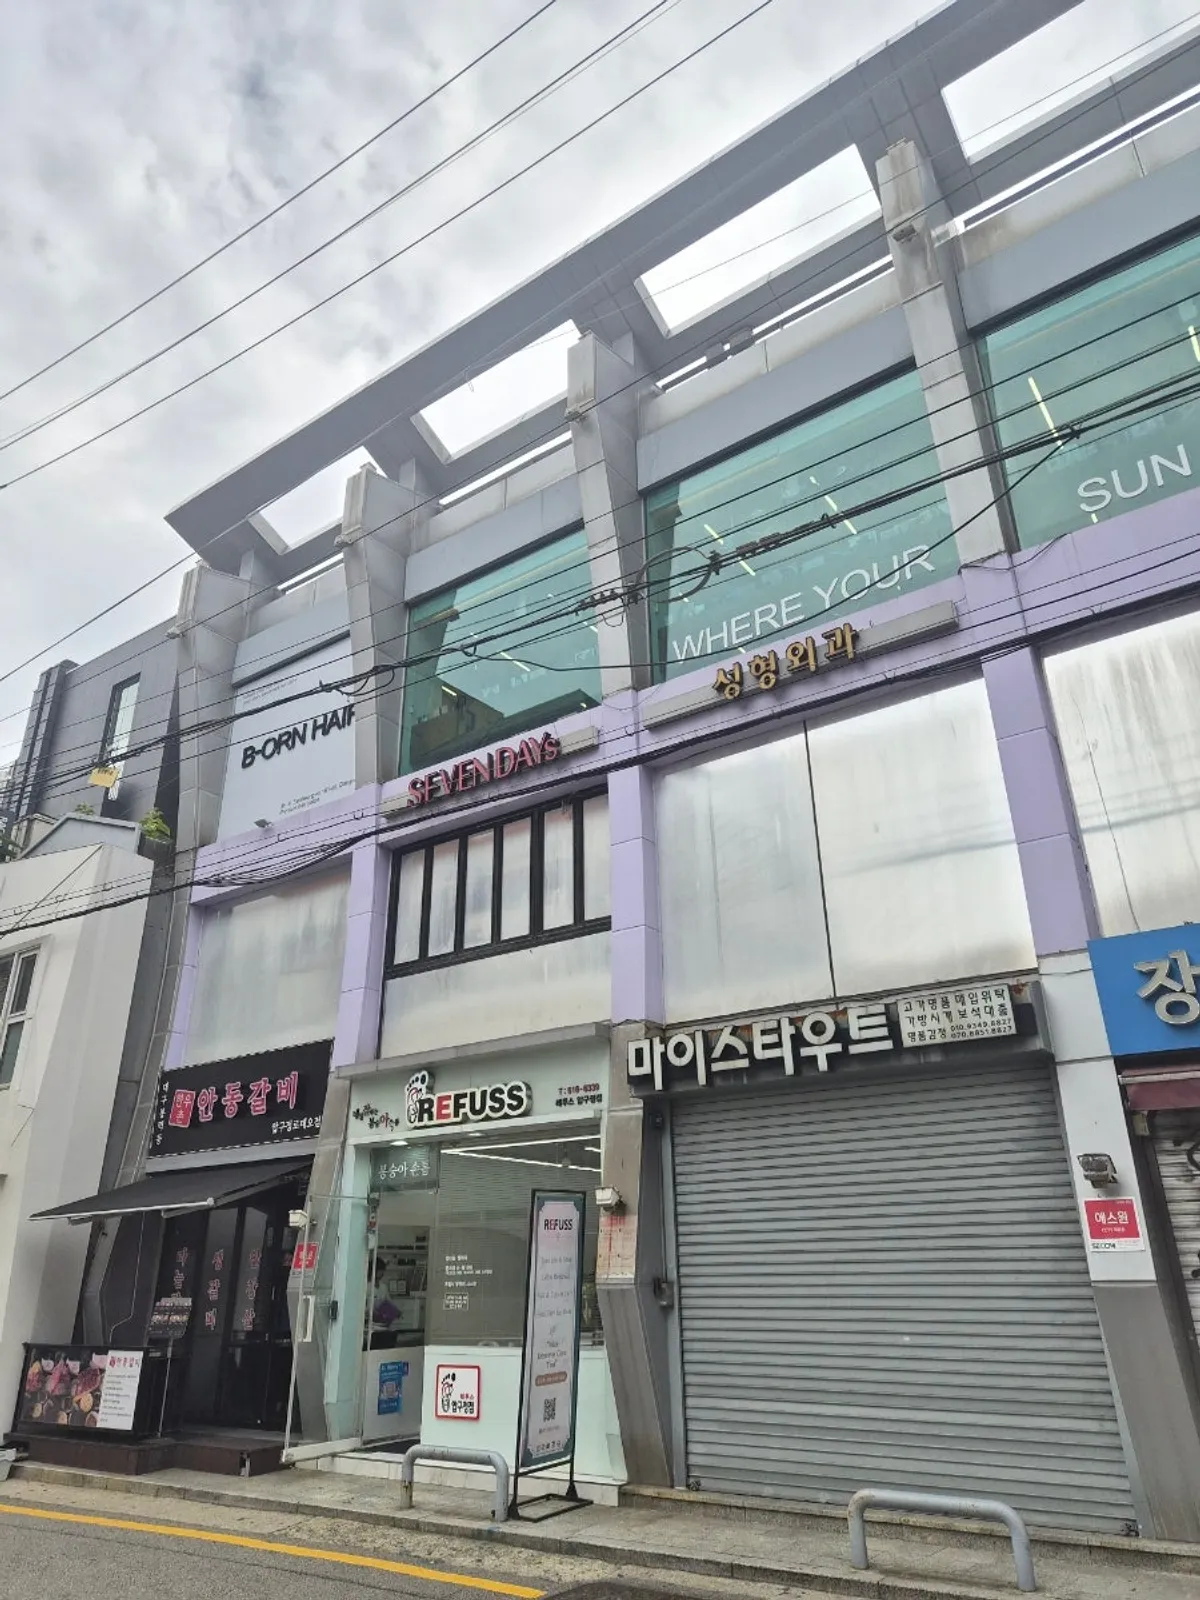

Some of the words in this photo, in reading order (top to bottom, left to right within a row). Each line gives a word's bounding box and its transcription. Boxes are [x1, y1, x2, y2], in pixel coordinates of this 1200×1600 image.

[1077, 443, 1192, 513] SUN
[672, 592, 806, 664] WHERE
[812, 544, 936, 609] YOUR
[712, 622, 859, 700] 성형외과
[241, 722, 308, 769] B-ORN
[406, 752, 492, 807] SEVEN
[1133, 949, 1200, 1025] 장
[627, 1002, 894, 1091] 마이스타우트
[197, 1071, 299, 1122] 안동갈비
[417, 1084, 525, 1123] REFUSS
[544, 1219, 573, 1231] REFUSS
